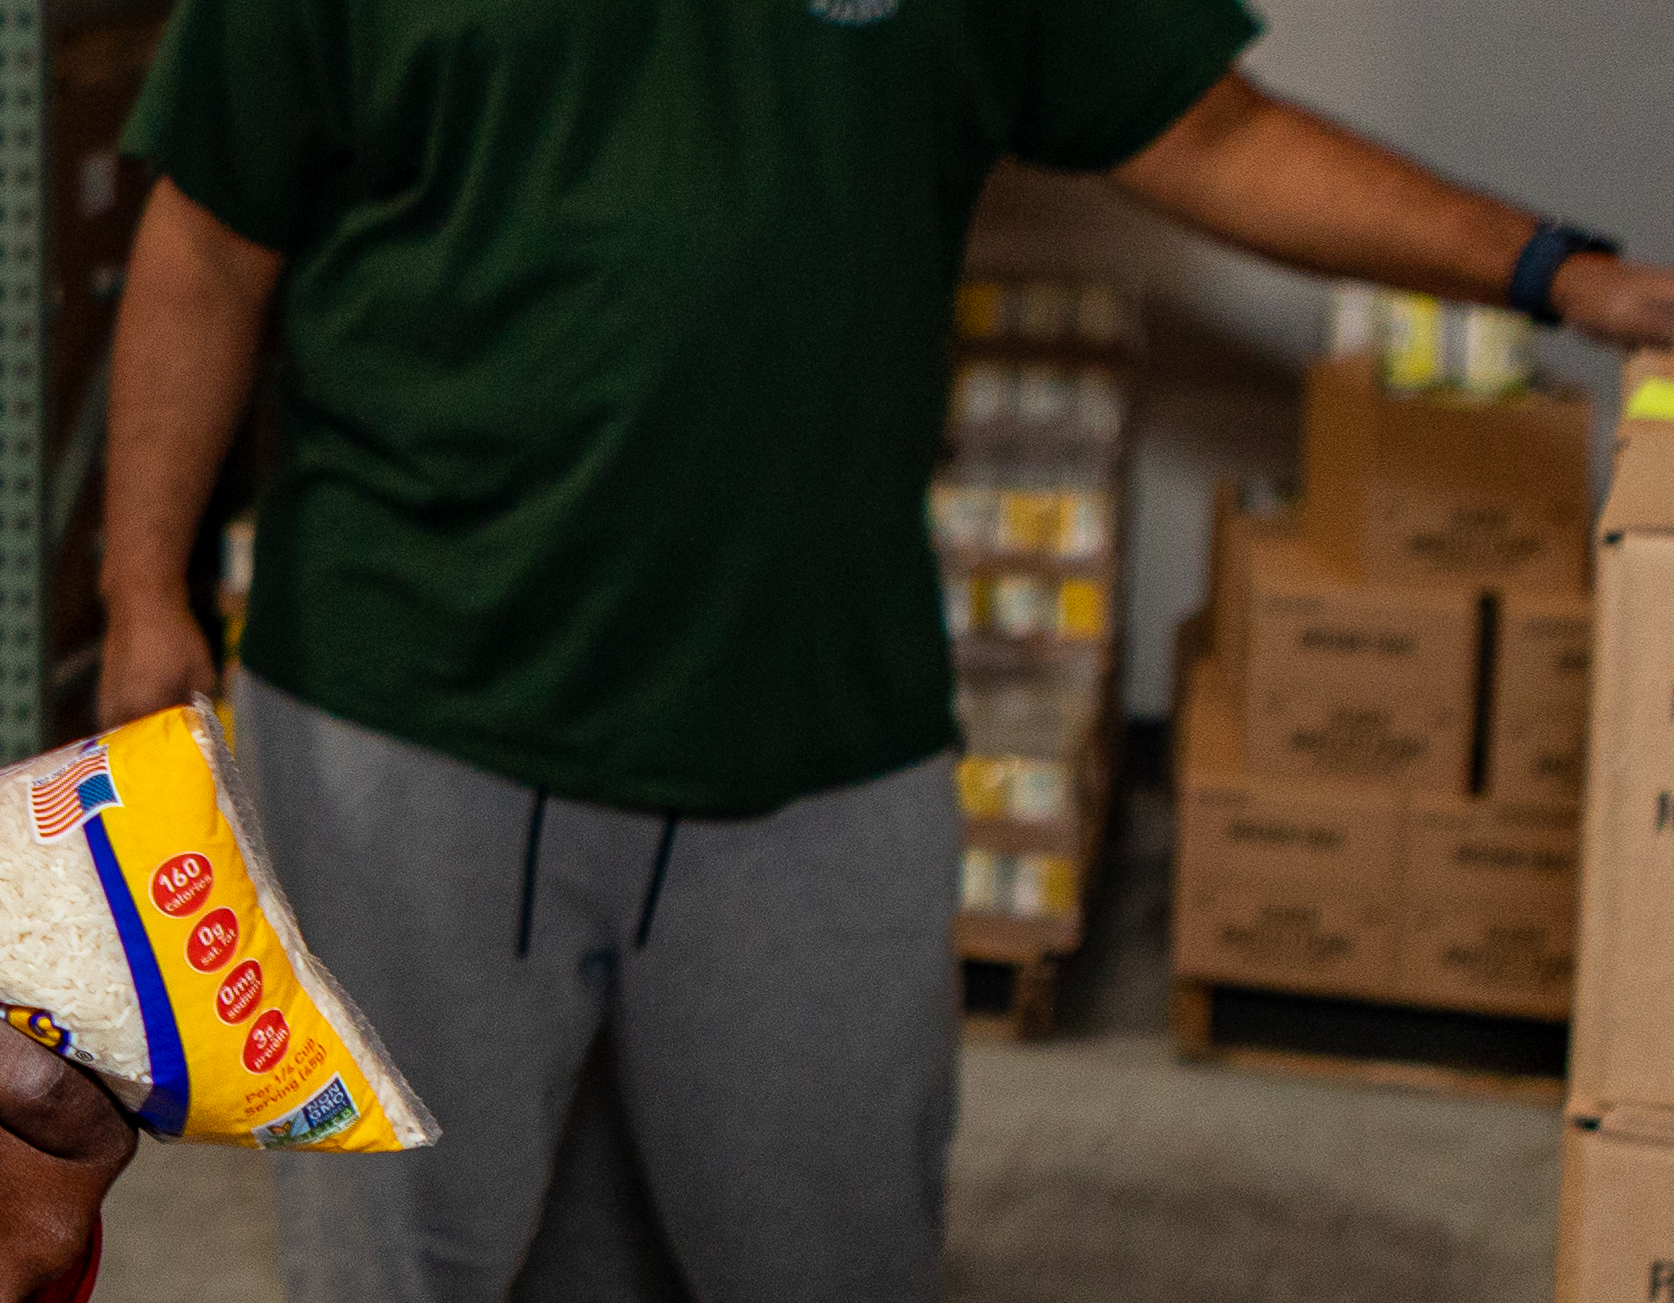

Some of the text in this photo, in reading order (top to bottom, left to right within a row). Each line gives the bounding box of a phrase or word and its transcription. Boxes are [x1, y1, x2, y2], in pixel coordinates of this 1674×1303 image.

[158, 857, 201, 894] 160
[164, 873, 213, 913] calories
[196, 922, 226, 947] 0g
[218, 968, 256, 1006] 0mg
[226, 978, 263, 1020] sodium
[252, 1025, 276, 1050] 3g
[253, 1027, 289, 1071] protein
[244, 1083, 272, 1104] Per
[293, 1038, 316, 1065] Cup
[244, 1080, 300, 1117] Serving
[305, 1080, 342, 1113] NON
[308, 1091, 346, 1123] GMO
